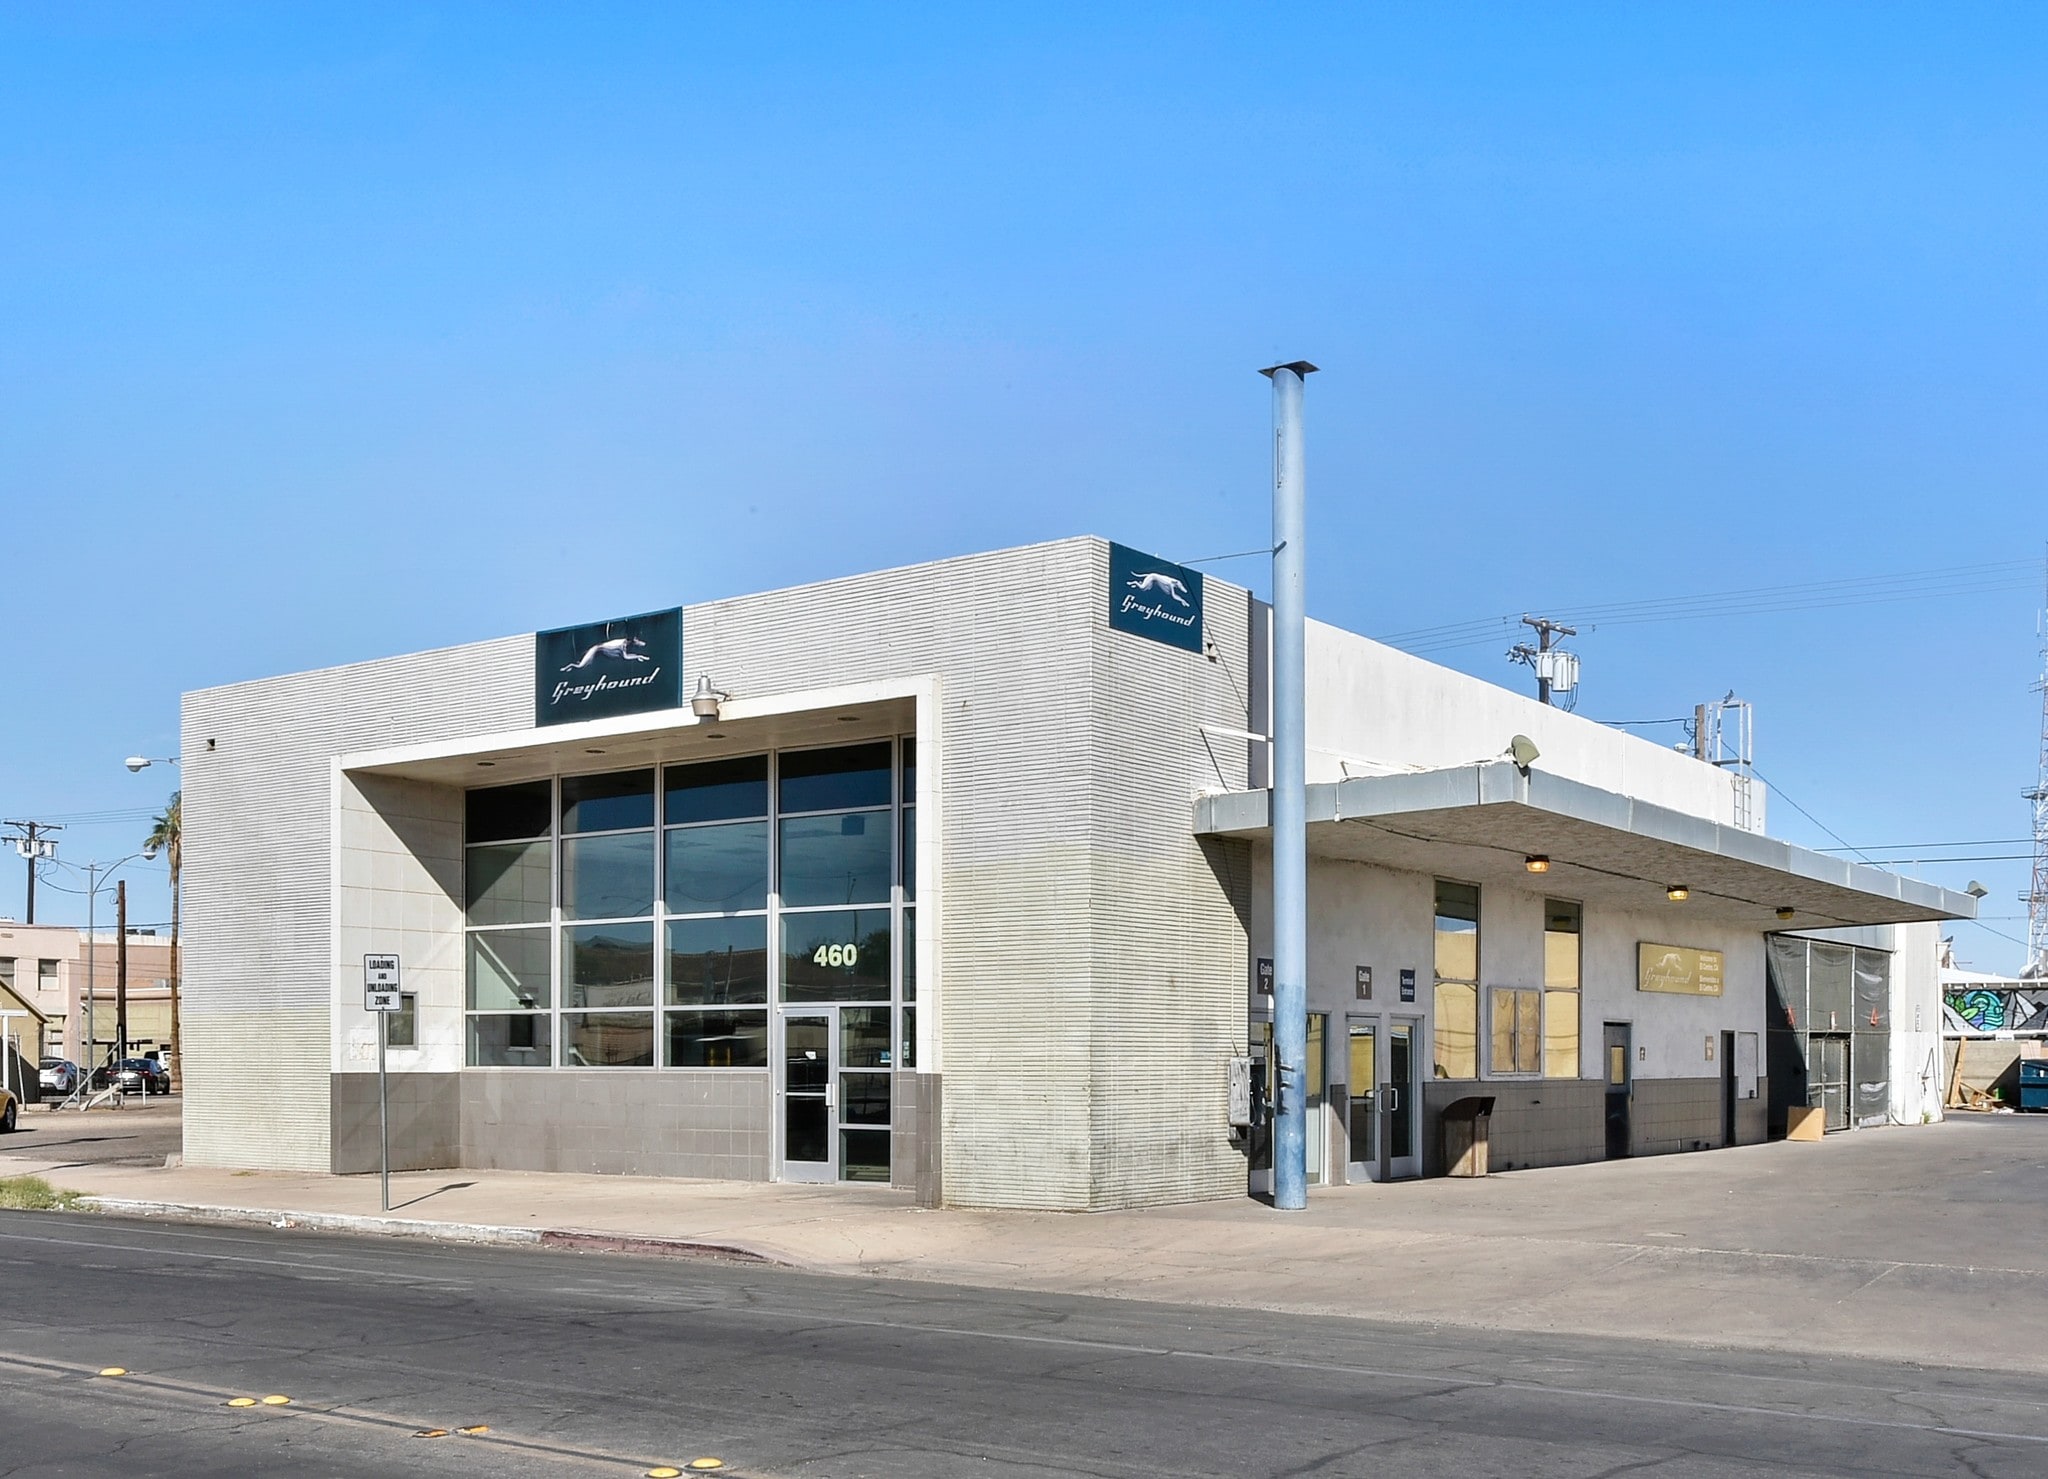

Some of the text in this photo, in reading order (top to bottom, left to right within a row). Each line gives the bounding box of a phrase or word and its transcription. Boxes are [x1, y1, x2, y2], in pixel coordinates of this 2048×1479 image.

[1120, 594, 1196, 627] Greyhound
[550, 666, 661, 705] Greyhound
[813, 943, 858, 967] 460
[369, 960, 395, 969] LOADING
[1260, 962, 1273, 976] Gate
[1358, 970, 1370, 982] Gate
[1643, 967, 1693, 988] Greyhound
[367, 983, 398, 992] UNLOADING
[1264, 977, 1269, 990] 2
[375, 996, 390, 1005] ZONE
